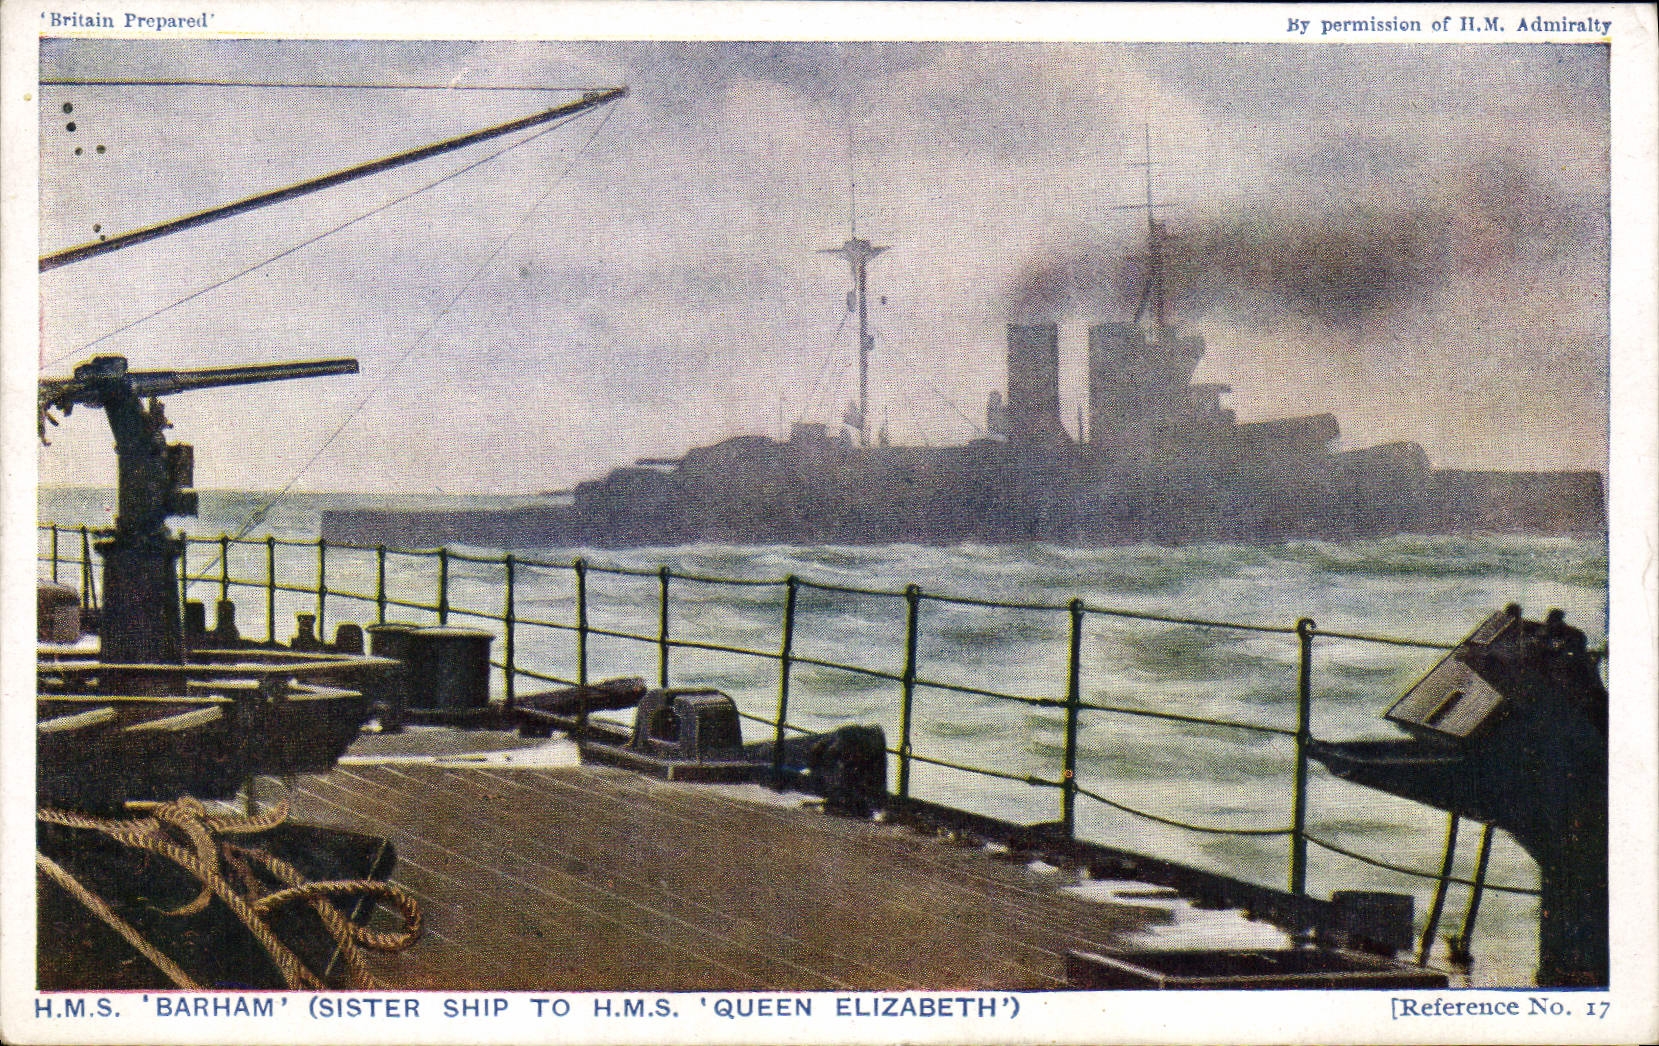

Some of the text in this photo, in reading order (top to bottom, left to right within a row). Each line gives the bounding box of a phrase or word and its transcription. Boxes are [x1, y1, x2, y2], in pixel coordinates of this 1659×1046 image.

[1287, 15, 1613, 35] By permission of H.M. Admiralty
[34, 996, 120, 1019] H.M.S.
[443, 997, 508, 1018] SHIP
[531, 997, 571, 1018] TO
[594, 997, 679, 1018] H.M.S.
[1527, 997, 1572, 1016] No.
[1586, 1001, 1611, 1020] 17
